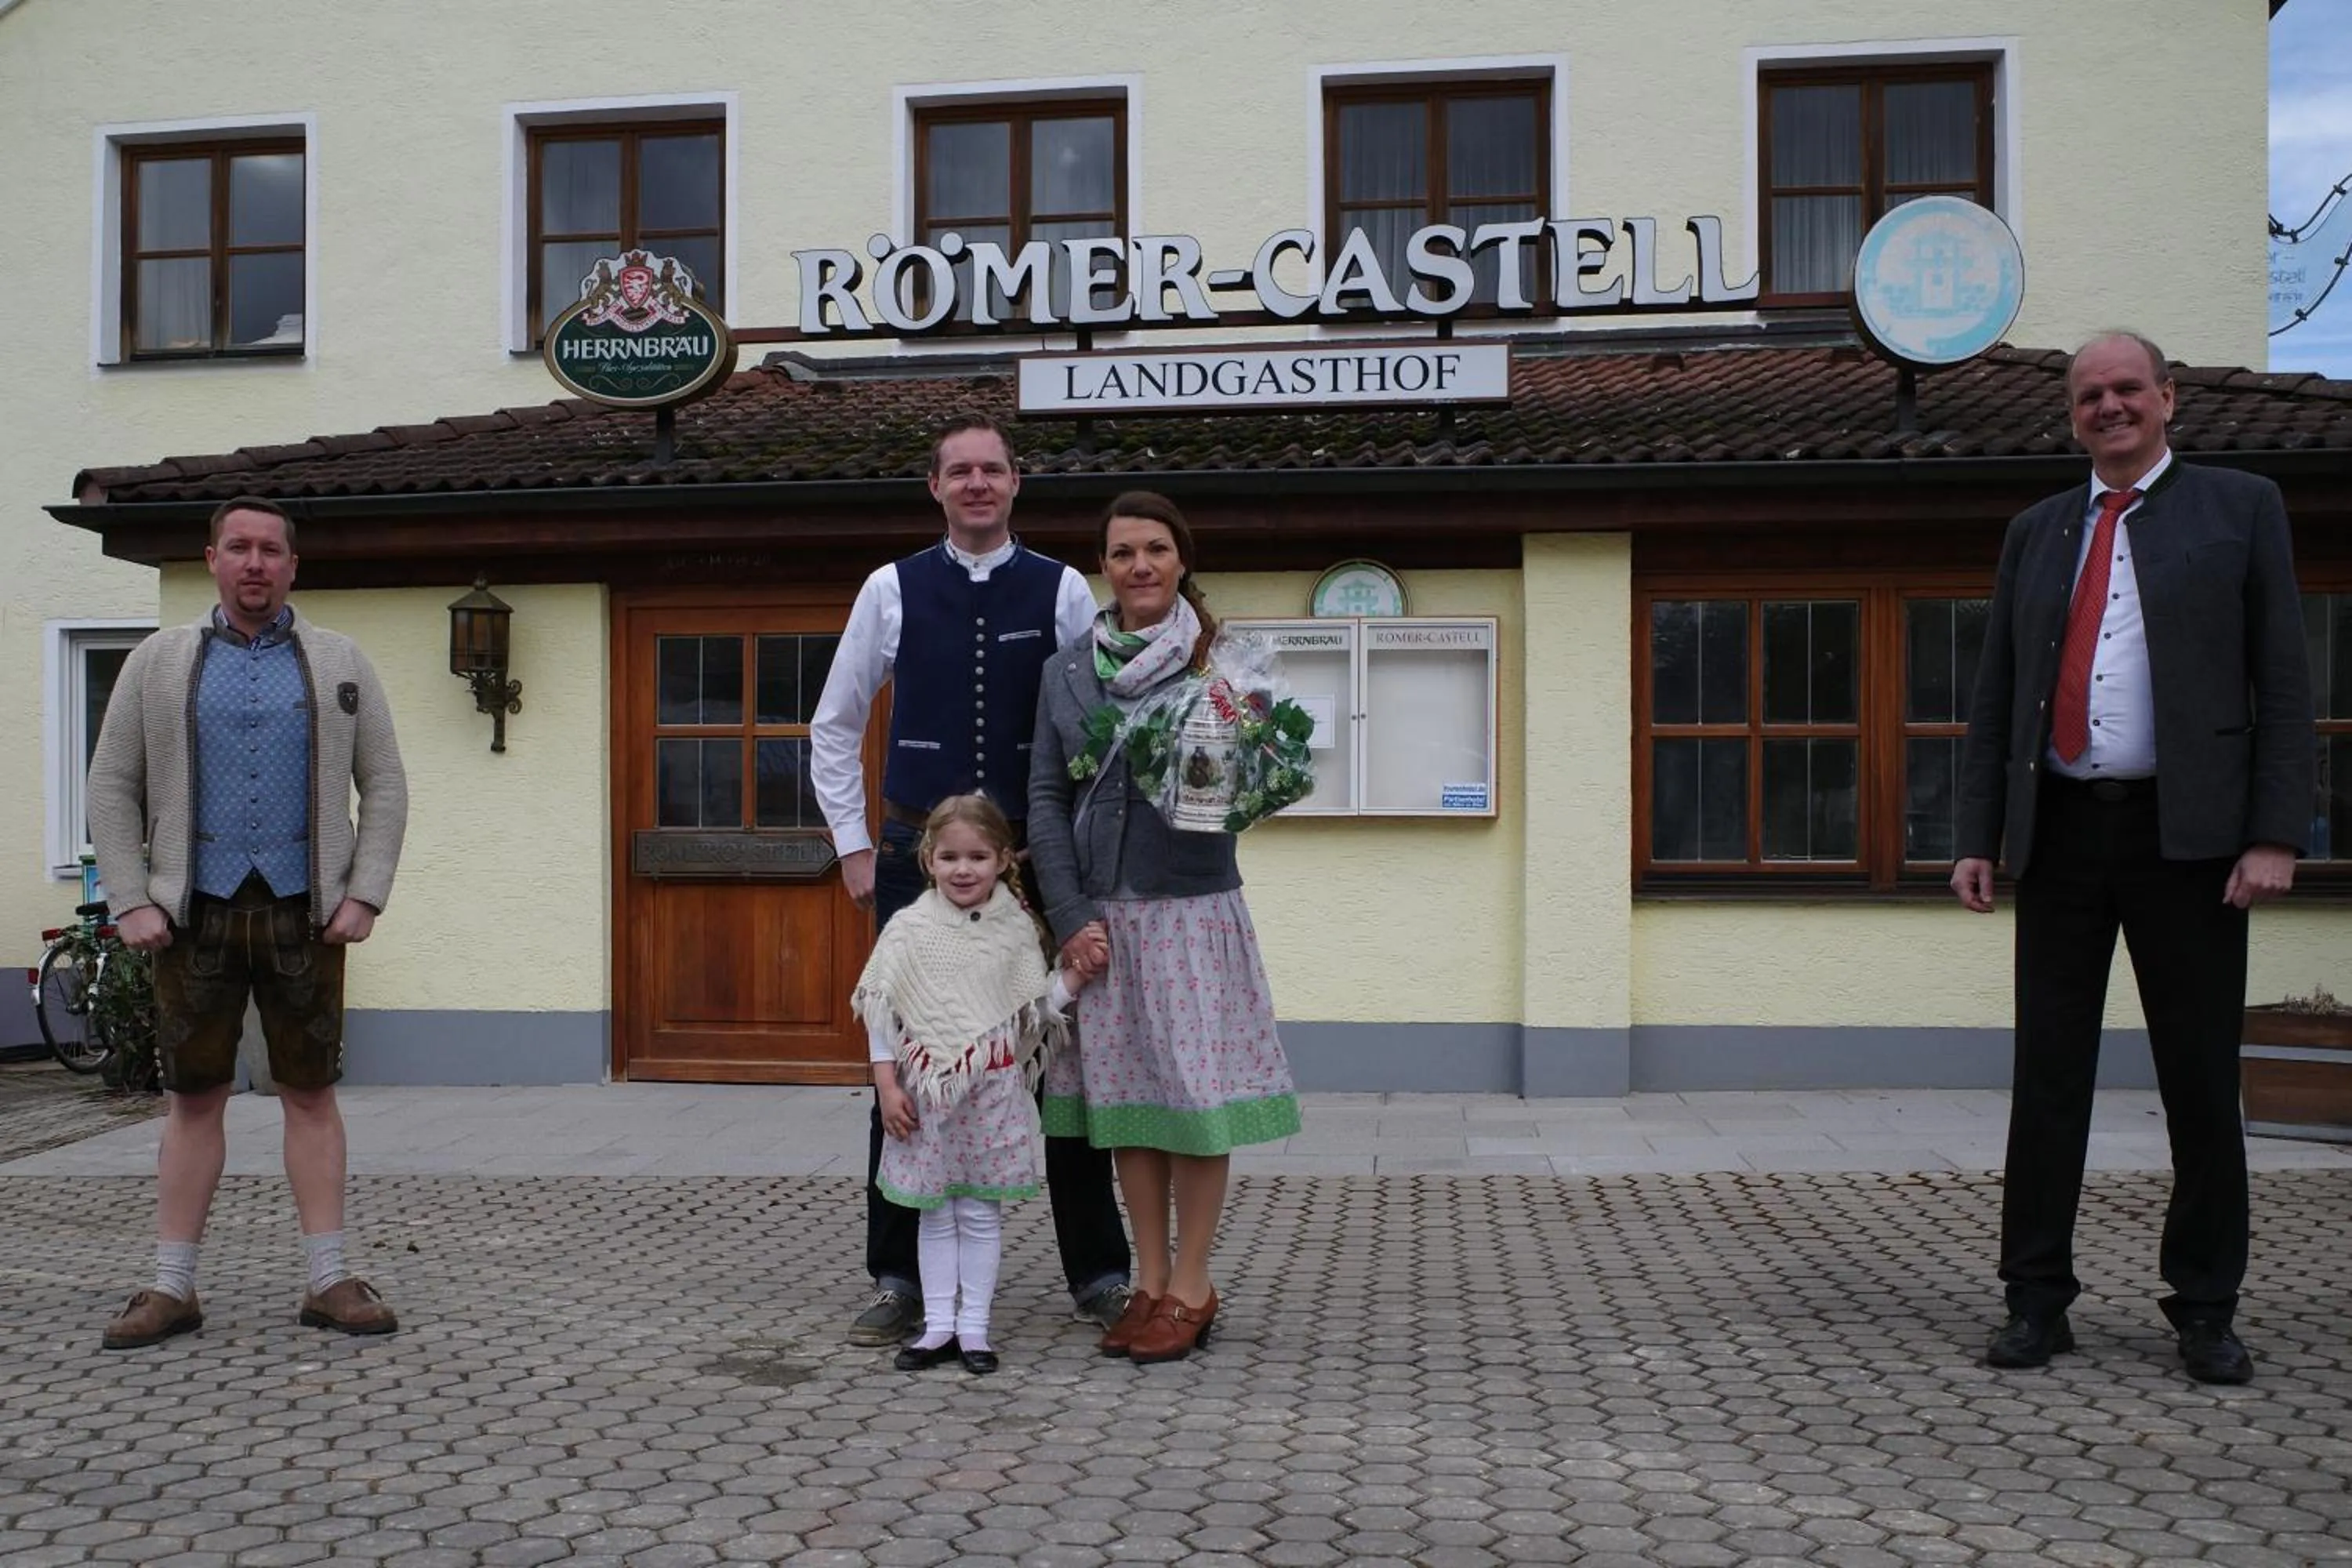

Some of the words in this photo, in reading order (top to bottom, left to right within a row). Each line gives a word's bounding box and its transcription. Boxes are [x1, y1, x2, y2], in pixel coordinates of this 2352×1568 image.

[792, 216, 1760, 332] RÖMER-CASTELL
[563, 335, 708, 360] HERRNBRÄU
[1063, 354, 1461, 401] LANDGASTHOF
